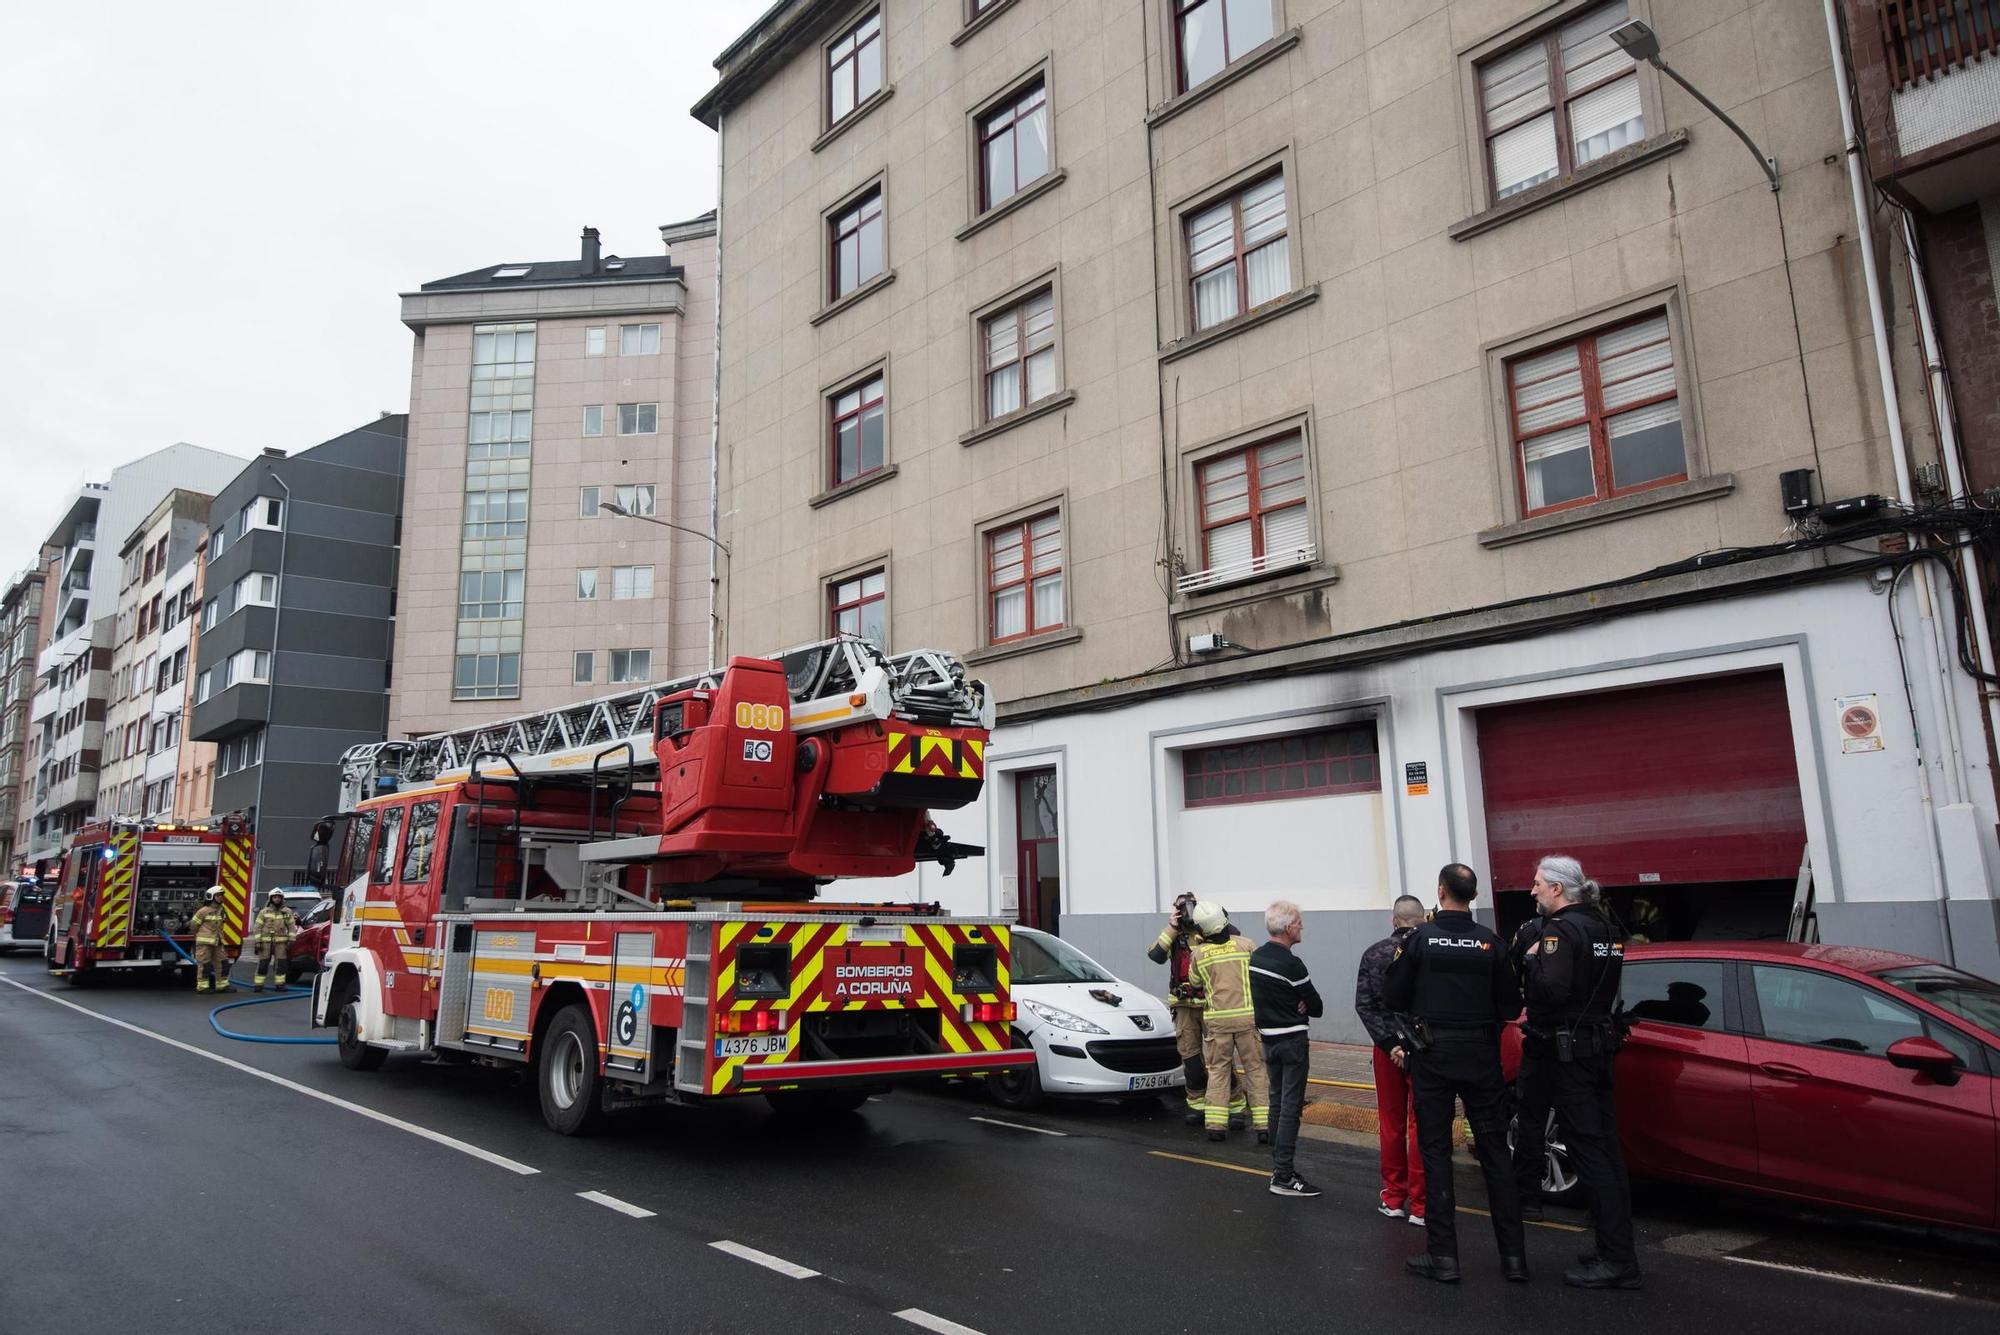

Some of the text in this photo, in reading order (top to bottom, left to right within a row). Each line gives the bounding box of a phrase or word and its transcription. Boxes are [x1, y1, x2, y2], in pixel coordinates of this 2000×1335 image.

[736, 702, 783, 731] 080
[1428, 938, 1482, 948] POLICIA
[836, 966, 913, 977] BOMBEIROS
[835, 978, 912, 995] A CORUÑA
[485, 988, 513, 1023] 080
[725, 1037, 787, 1054] 4376 JBM
[1135, 1077, 1156, 1088] 5749
